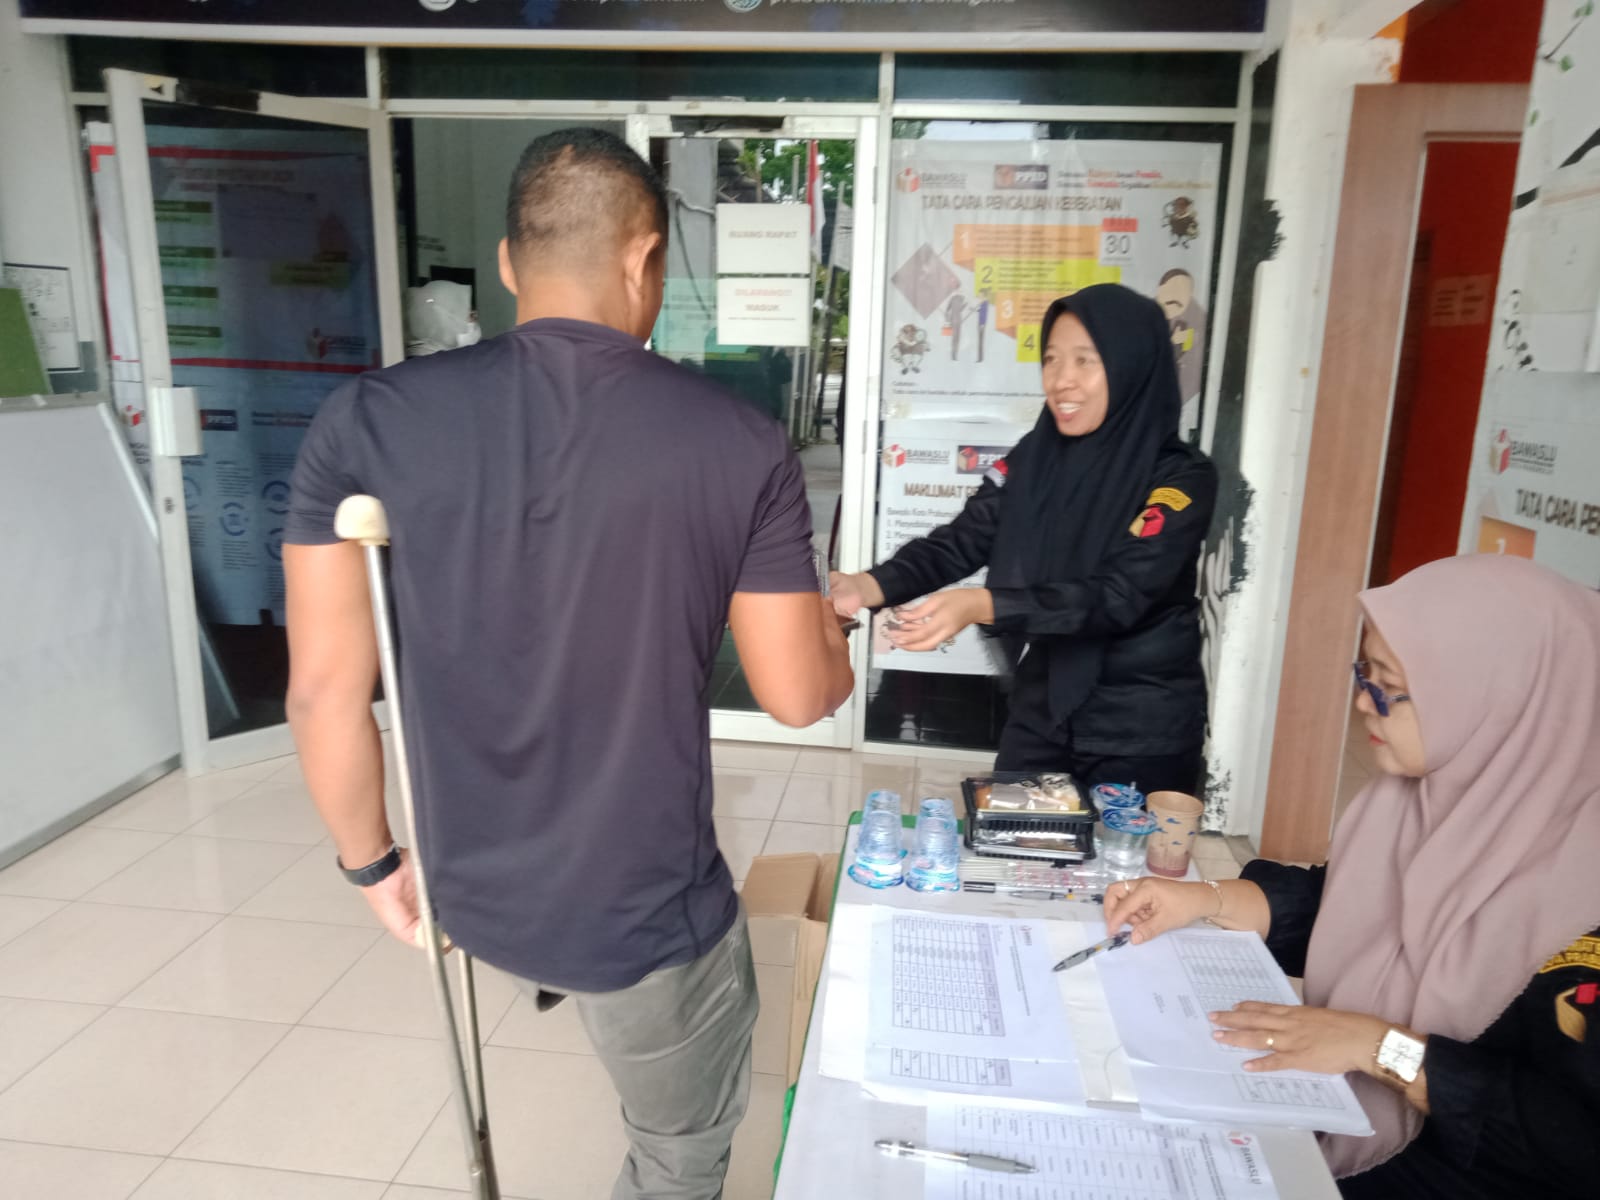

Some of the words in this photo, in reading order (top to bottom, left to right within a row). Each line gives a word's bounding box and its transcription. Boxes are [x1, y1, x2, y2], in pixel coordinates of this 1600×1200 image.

[921, 195, 950, 210] TATA
[954, 195, 982, 210] CARA
[1105, 234, 1131, 254] 30
[981, 265, 993, 284] 2
[1002, 301, 1014, 320] 3
[1023, 334, 1036, 351] 4
[904, 482, 963, 498] MAKLUMAT
[1516, 488, 1543, 520] TATA
[1545, 495, 1580, 530] CARA
